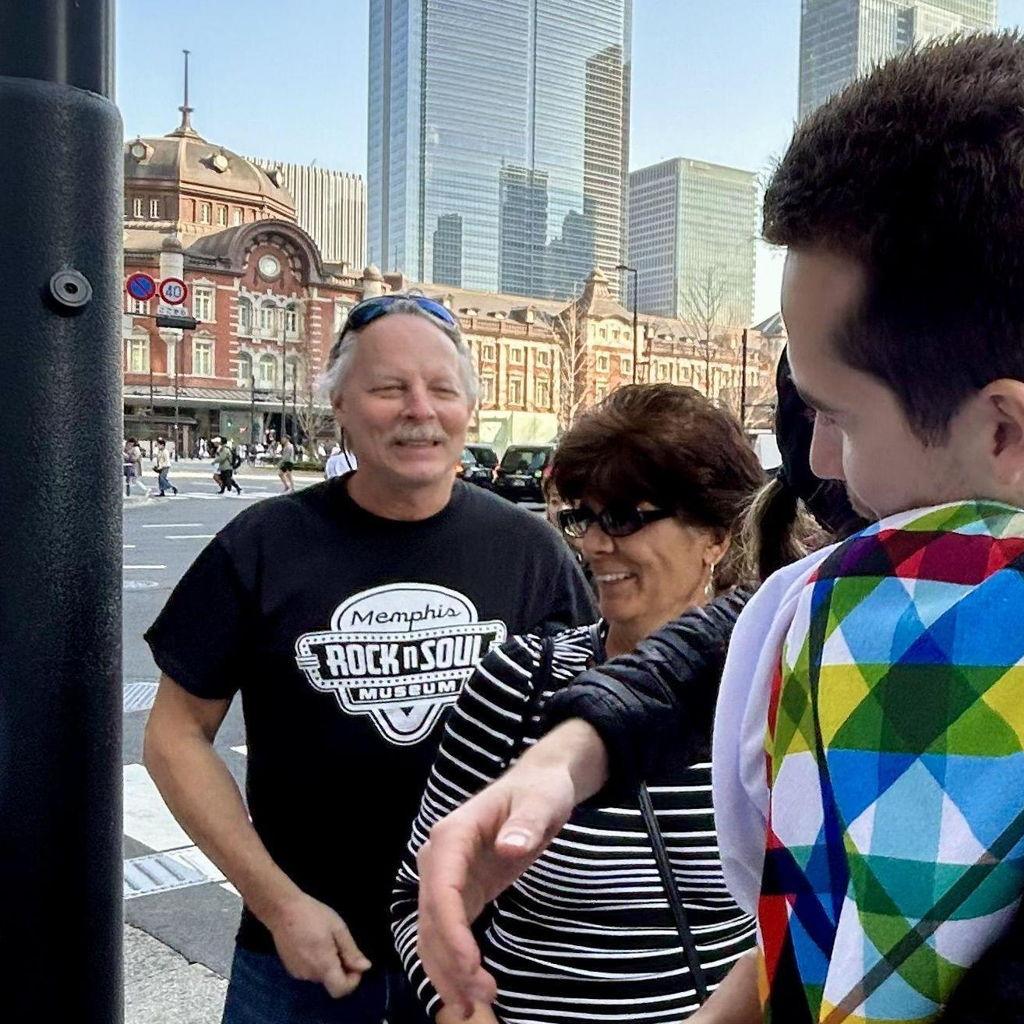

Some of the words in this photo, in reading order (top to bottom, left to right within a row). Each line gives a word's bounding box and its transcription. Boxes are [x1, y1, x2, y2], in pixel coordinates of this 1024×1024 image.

[165, 285, 181, 298] 40
[351, 604, 461, 631] Memphis
[325, 643, 400, 677] ROCK
[420, 635, 483, 671] SOUL
[359, 680, 456, 700] MUSEUM
